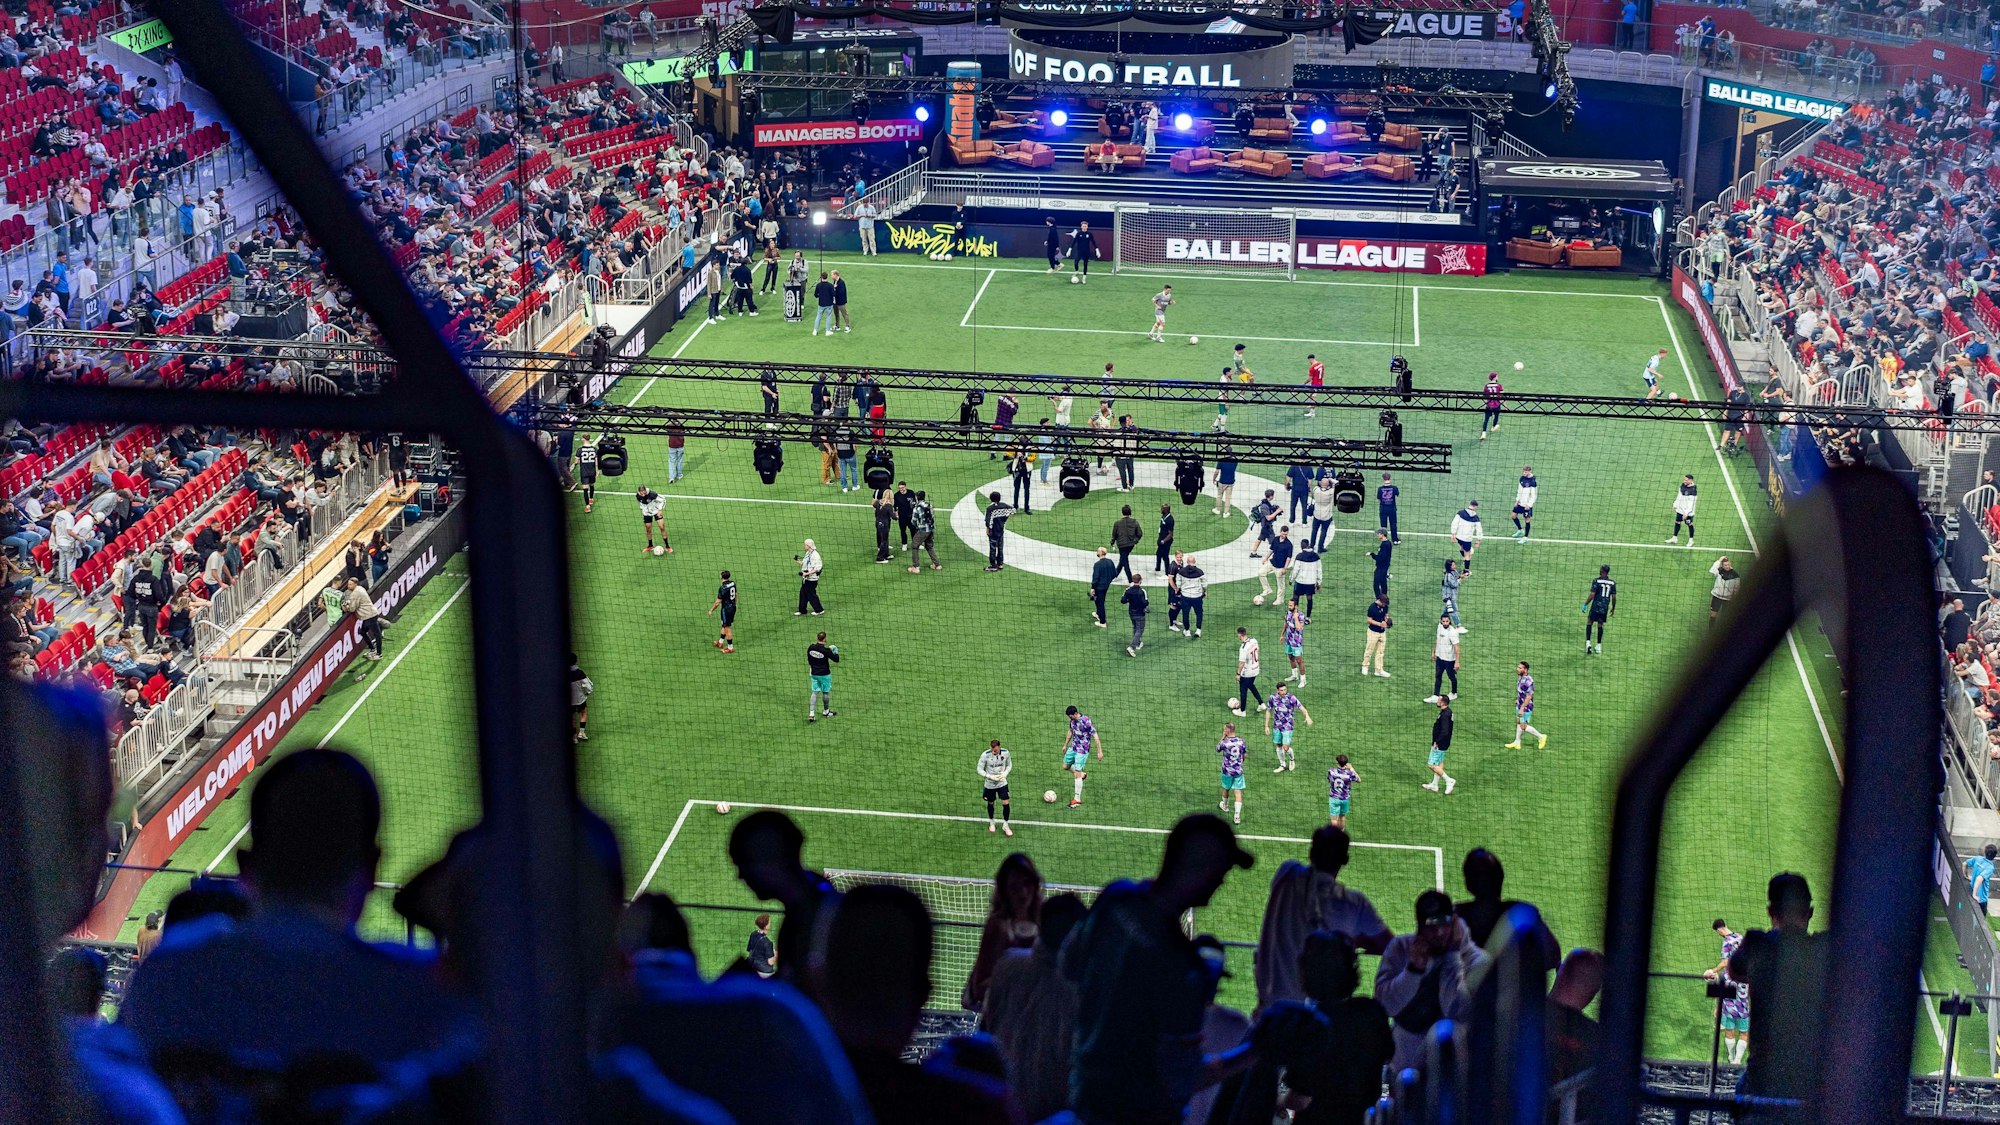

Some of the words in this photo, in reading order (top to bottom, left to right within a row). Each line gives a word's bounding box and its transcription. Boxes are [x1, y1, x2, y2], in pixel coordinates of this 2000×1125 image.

[1357, 12, 1483, 36] AGUE
[142, 23, 164, 46] XING
[1015, 49, 1038, 77] OF
[1044, 57, 1242, 89] FOOTBALL
[1708, 82, 1773, 109] BALLER
[1775, 95, 1844, 121] LEAGUE
[758, 126, 856, 143] MANAGERS
[858, 124, 920, 140] BOOTH
[223, 222, 235, 236] 022
[1166, 238, 1291, 263] BALLER
[1297, 242, 1427, 269] LEAGUE
[86, 299, 99, 316] 022
[392, 435, 400, 447] 6
[581, 451, 596, 463] 22
[730, 586, 736, 600] 9
[1601, 583, 1611, 598] 11
[324, 594, 337, 608] 10
[1251, 648, 1258, 664] 10
[166, 733, 254, 842] WELCOME
[253, 711, 277, 751] TO
[279, 702, 291, 730] A
[291, 658, 323, 714] NEW
[324, 630, 354, 678] ERA
